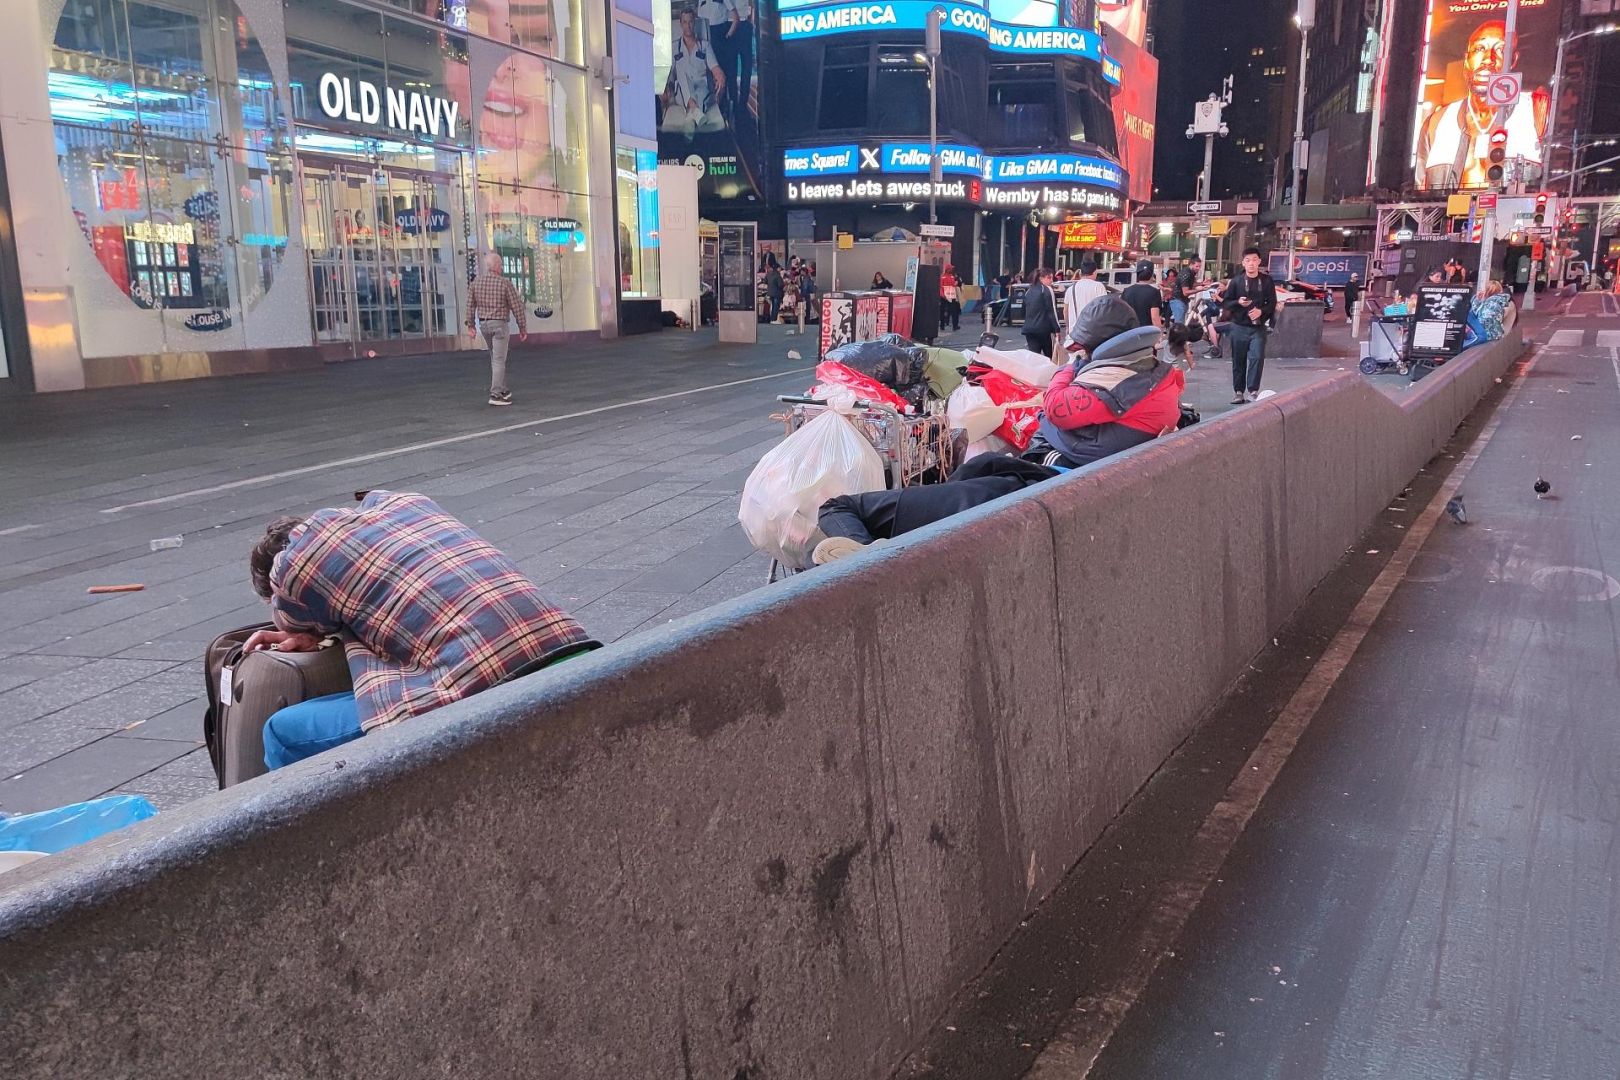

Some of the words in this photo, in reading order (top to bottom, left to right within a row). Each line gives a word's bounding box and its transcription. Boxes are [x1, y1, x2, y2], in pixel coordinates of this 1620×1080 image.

[1449, 4, 1469, 13] You
[1470, 2, 1497, 11] Only
[816, 4, 896, 31] AMERICA
[951, 7, 986, 32] GOOD
[1013, 31, 1086, 51] AMERICA
[320, 72, 380, 124] OLD
[386, 86, 459, 138] NAVY
[811, 150, 850, 172] Square!
[941, 149, 965, 167] GMA
[966, 156, 976, 168] on
[999, 161, 1024, 176] Like
[1026, 159, 1058, 175] GMA
[1060, 163, 1073, 175] on
[709, 163, 736, 175] hulu
[801, 181, 843, 199] leaves
[846, 179, 883, 197] Jets
[985, 186, 1040, 205] Wemby
[1043, 186, 1069, 202] has
[1071, 187, 1087, 203] 5x5
[1087, 192, 1104, 207] game
[398, 215, 416, 228] OLD
[558, 221, 577, 229] NAVY
[1306, 259, 1350, 275] pepsi
